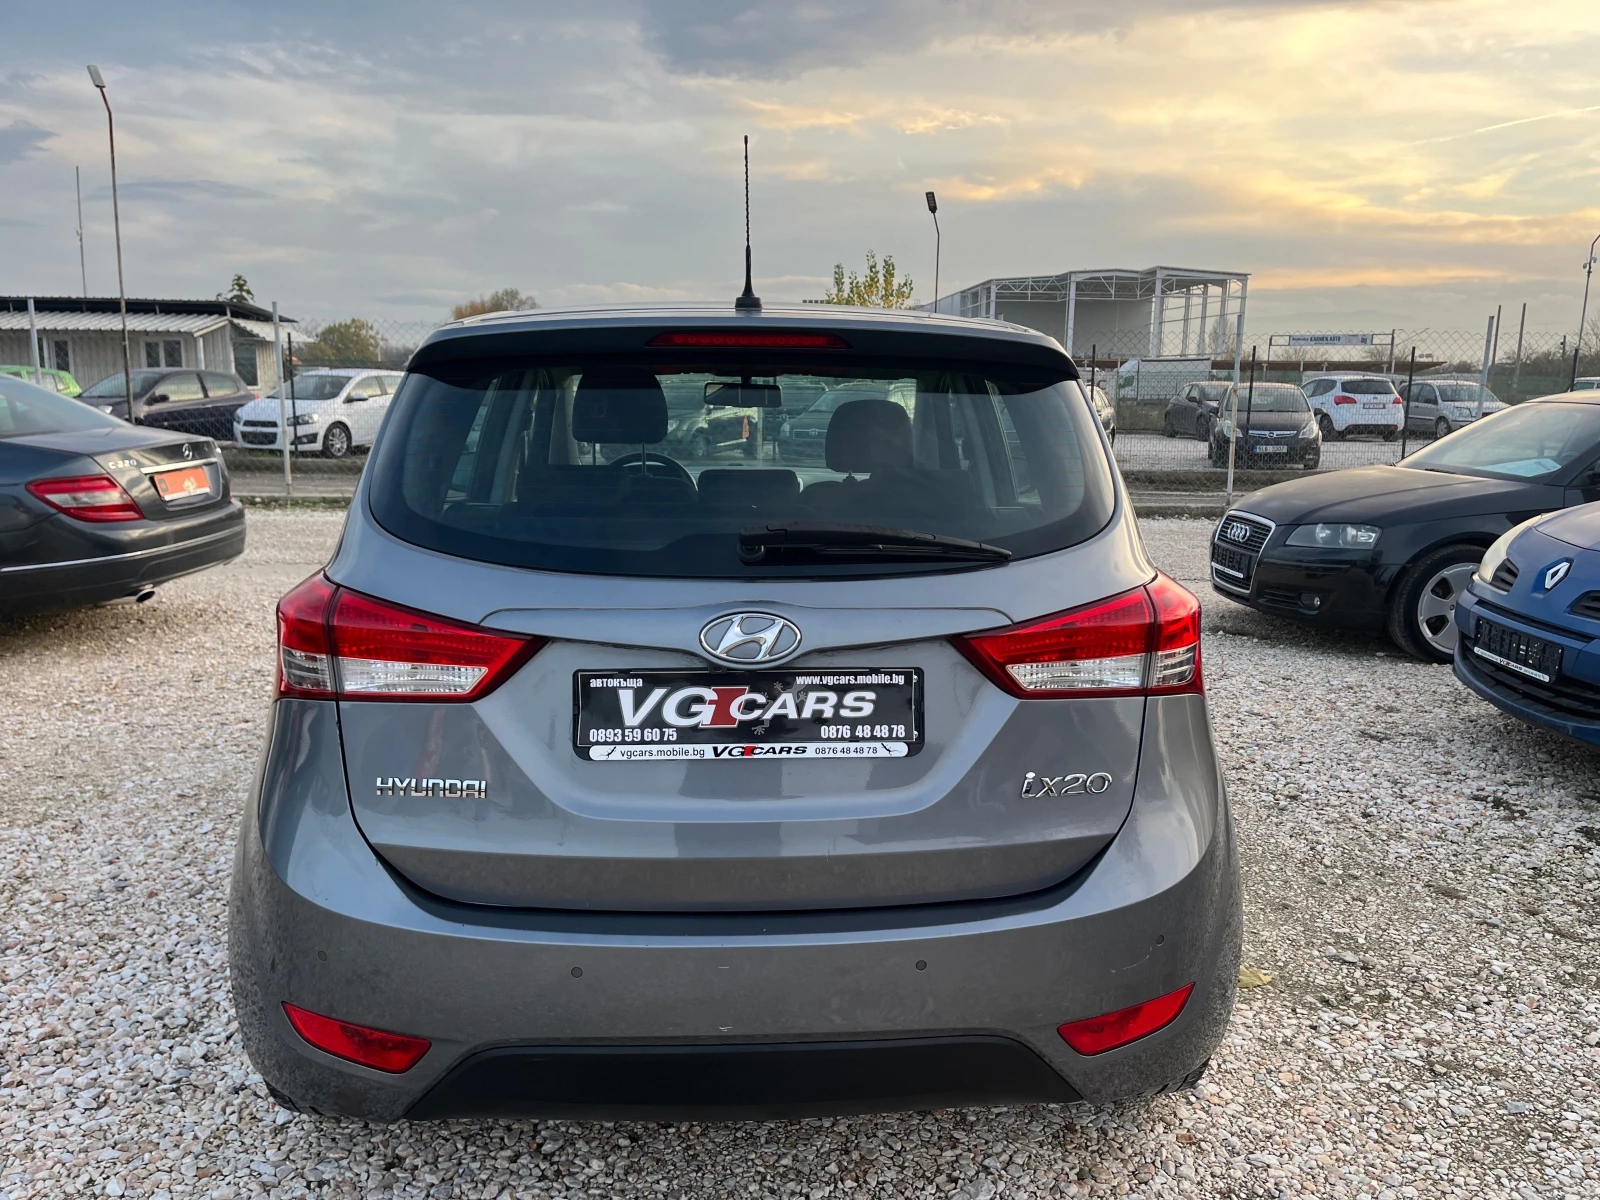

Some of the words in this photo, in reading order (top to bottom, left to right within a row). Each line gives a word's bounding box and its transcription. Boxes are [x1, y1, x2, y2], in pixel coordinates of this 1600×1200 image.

[589, 678, 643, 688] автокъща
[796, 674, 905, 685] www.vgcars.mobile.bg
[589, 729, 622, 742] 0893
[624, 729, 642, 742] 59
[643, 728, 661, 741] 60
[662, 728, 678, 741] 75
[820, 725, 851, 739] 0876
[855, 725, 871, 738] 48
[873, 725, 889, 738] 48
[891, 725, 906, 738] 78
[620, 747, 705, 759] vgcars.mobile.bg
[815, 747, 838, 755] 0876
[839, 747, 851, 755] 48
[853, 747, 864, 755] 48
[867, 747, 878, 755] 78
[376, 777, 486, 799] HYUNDAI
[1021, 771, 1113, 799] ix20
